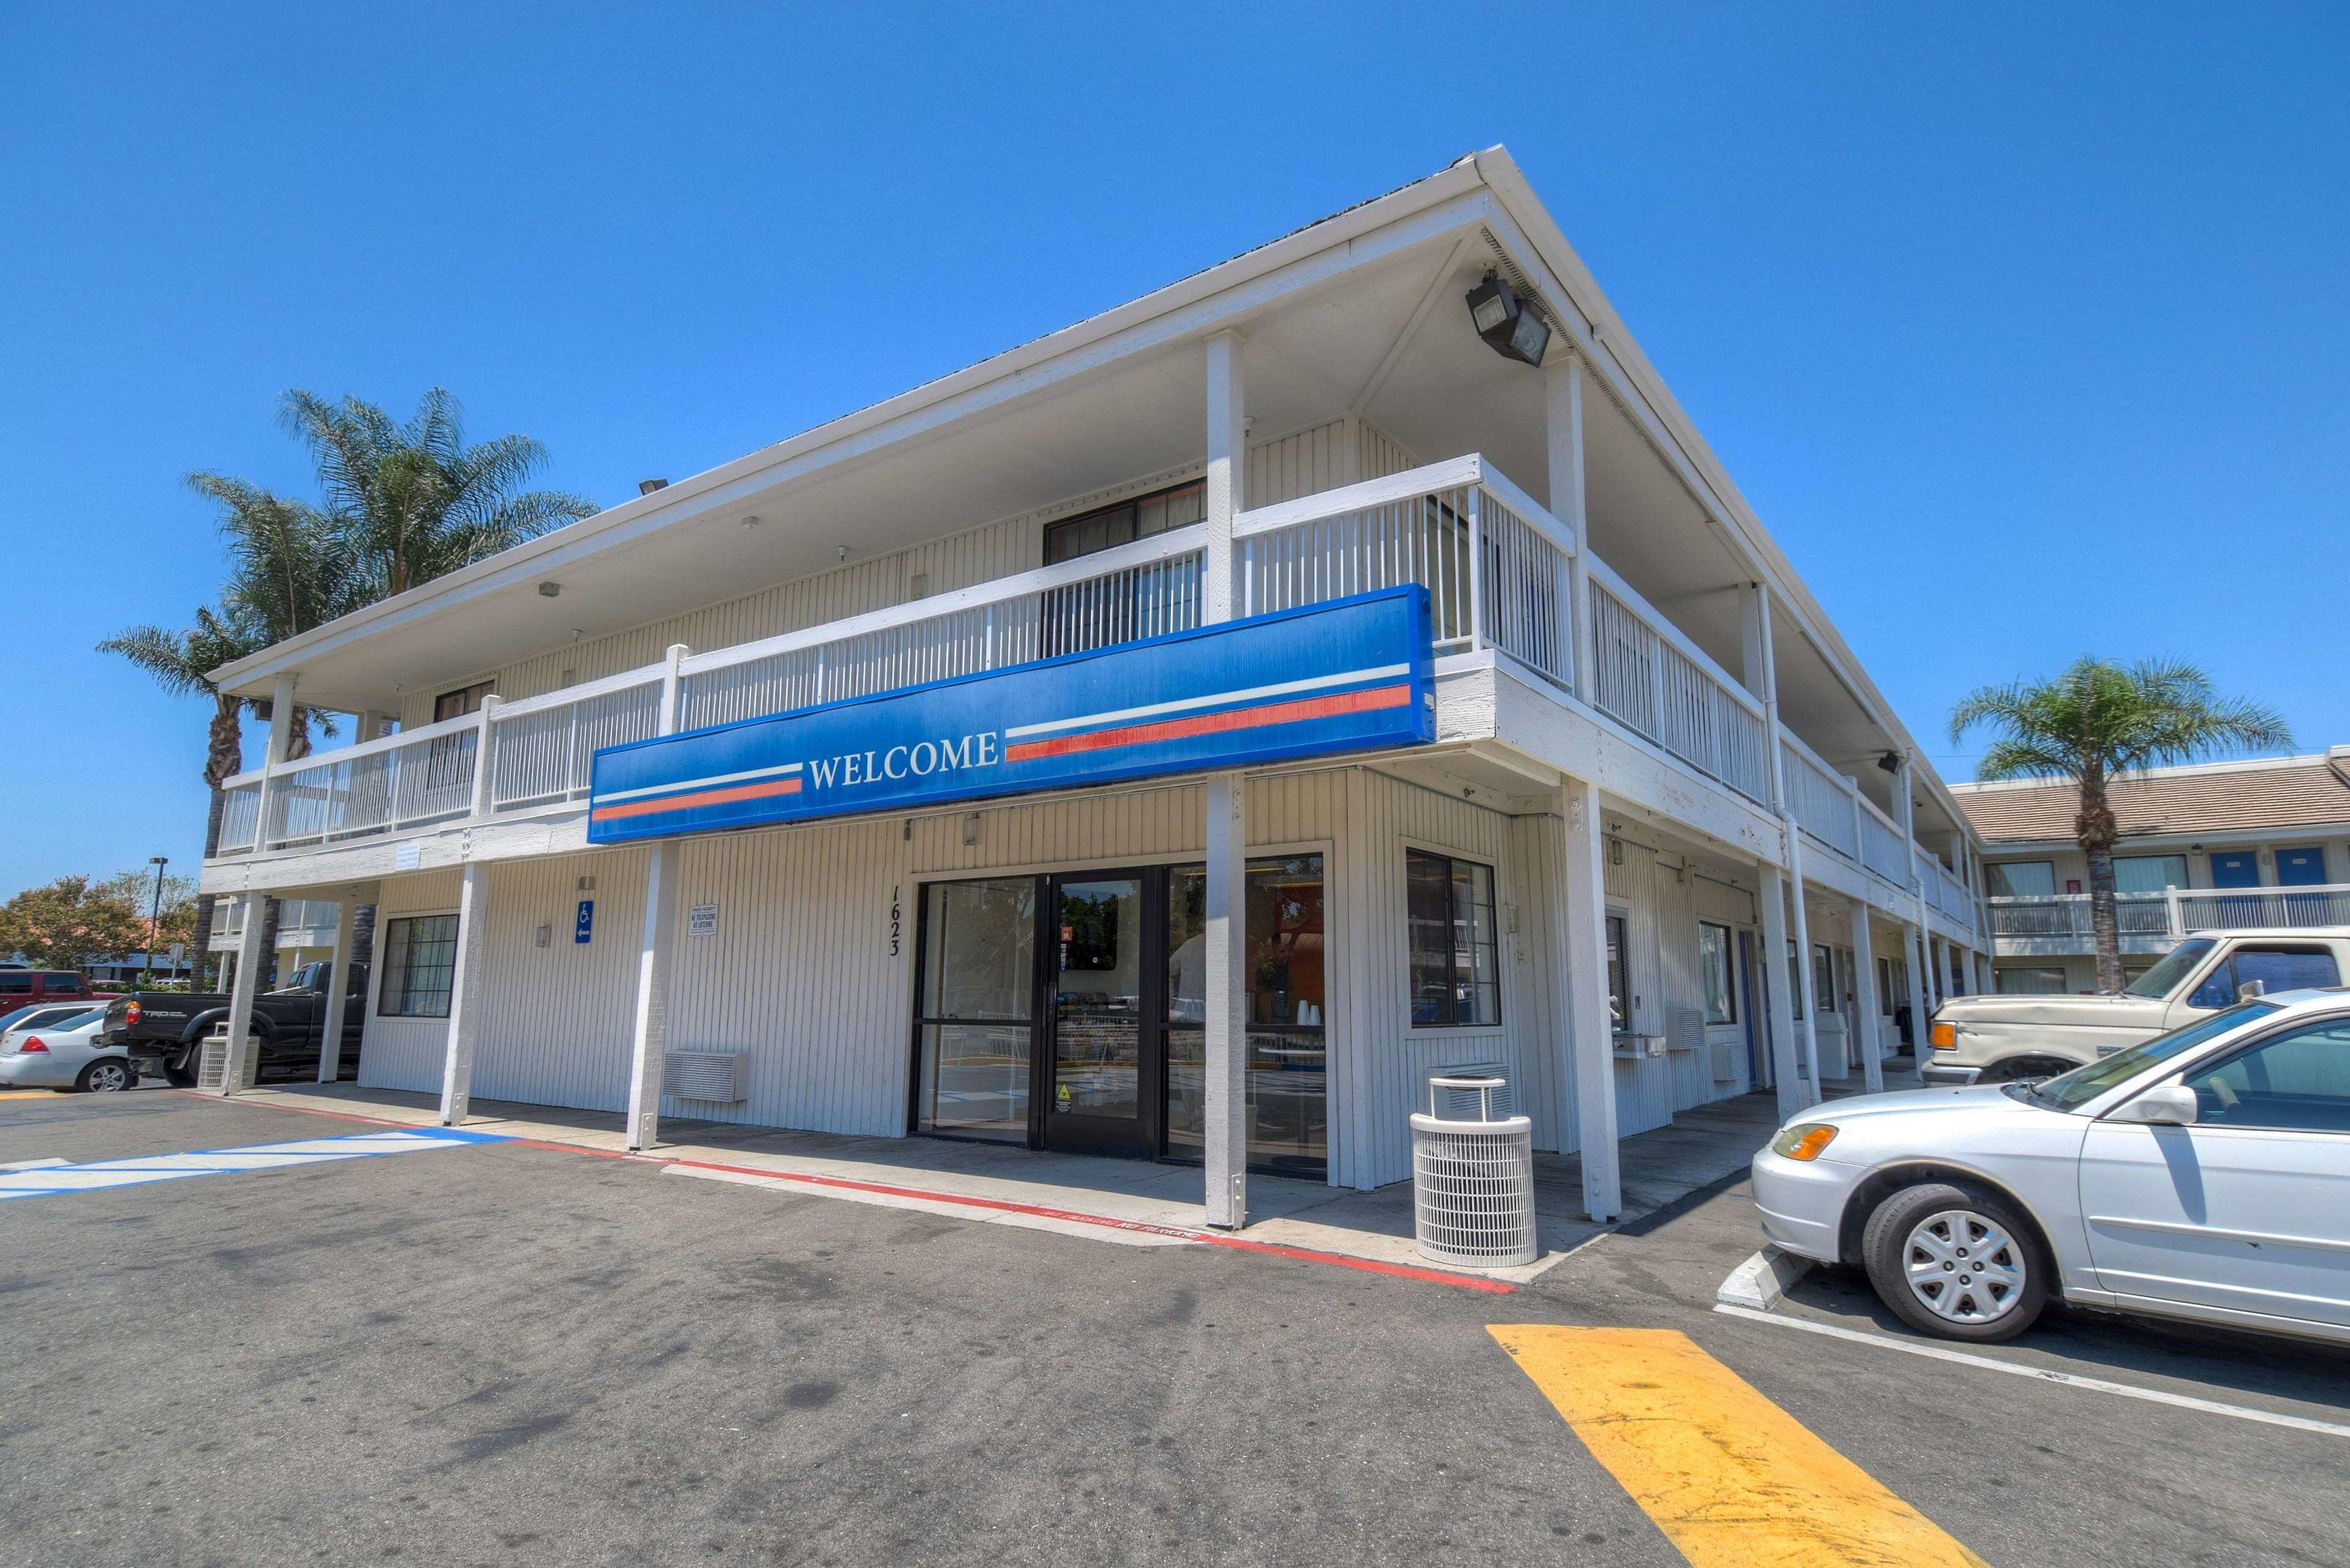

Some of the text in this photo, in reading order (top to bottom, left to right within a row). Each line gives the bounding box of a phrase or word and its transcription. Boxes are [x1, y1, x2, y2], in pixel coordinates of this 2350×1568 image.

[809, 732, 998, 790] WELCOME
[890, 885, 900, 956] 1623
[1139, 1225, 1201, 1238] PARKING
